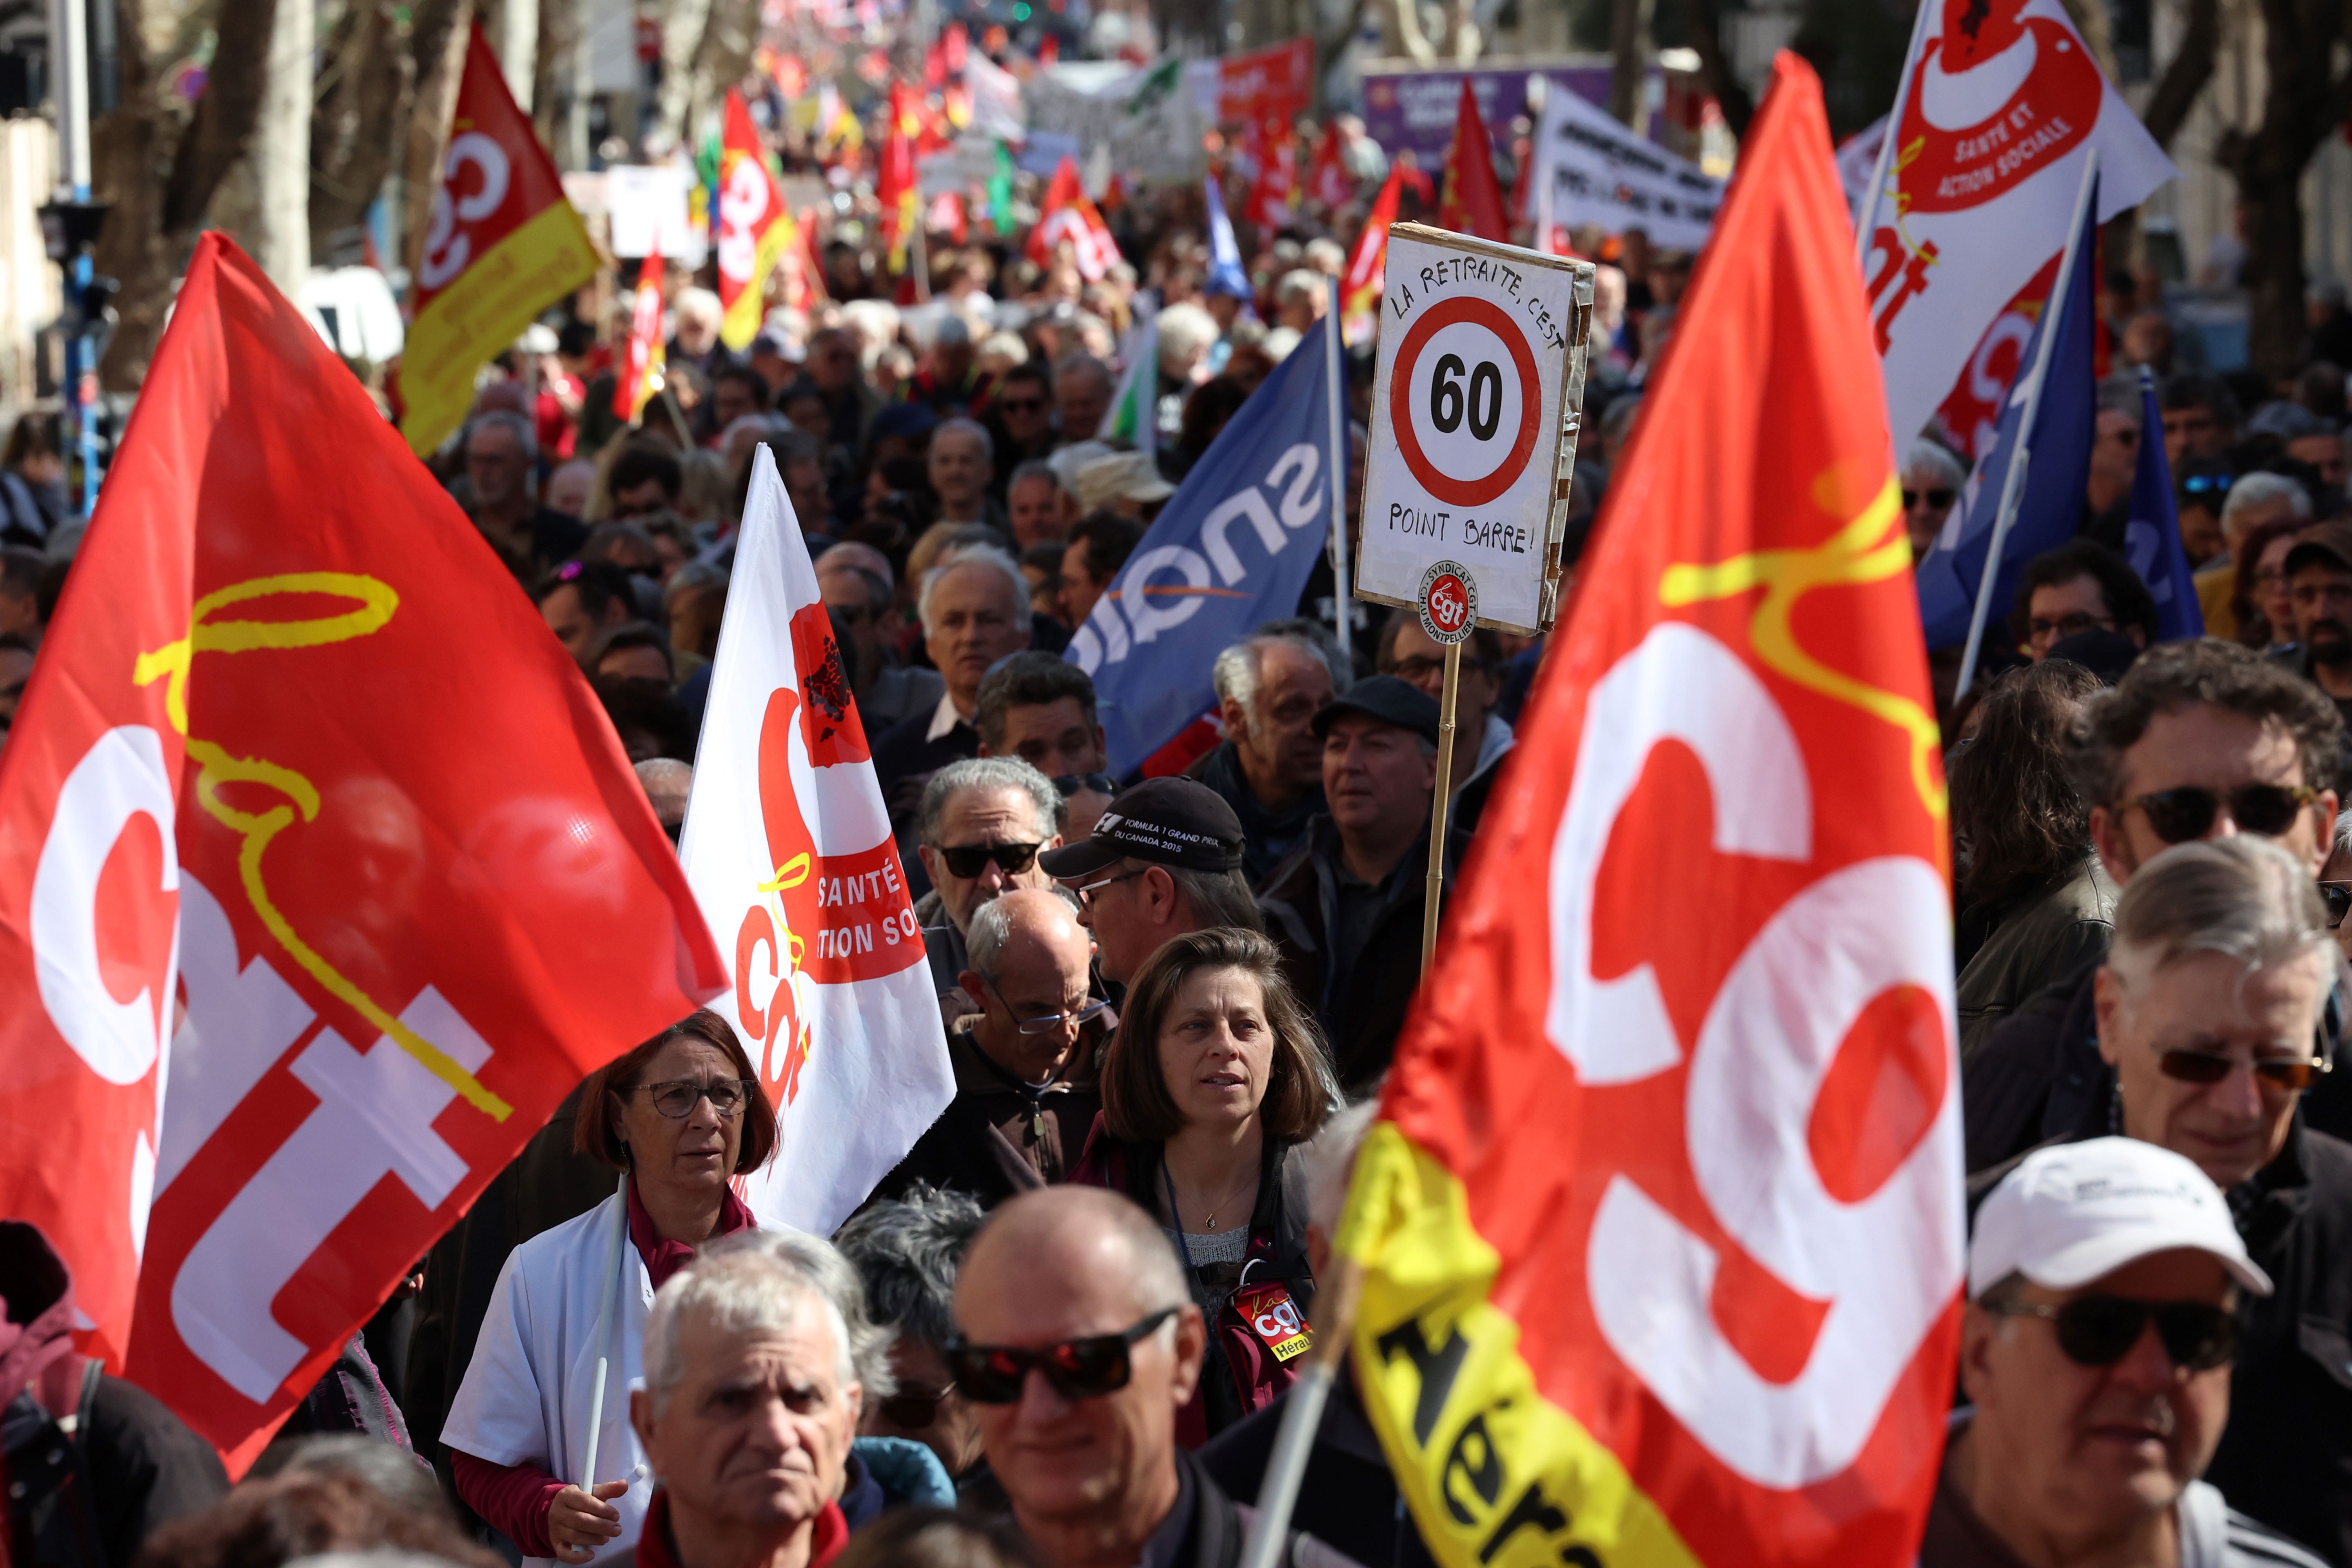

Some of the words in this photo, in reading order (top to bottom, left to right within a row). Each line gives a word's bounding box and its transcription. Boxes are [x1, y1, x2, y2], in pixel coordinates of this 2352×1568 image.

[1996, 116, 2073, 177] SOCIALE
[1390, 284, 1414, 319] LA
[1420, 256, 1522, 304] RETRAITE,
[1528, 298, 1565, 349] C'EST
[1430, 353, 1502, 441] 60
[1428, 563, 1471, 584] SYNDICAT
[1468, 586, 1476, 612] CGT
[1431, 592, 1464, 626] cgt
[1423, 617, 1473, 642] MONTPELLIER
[1114, 830, 1125, 838] DU
[1125, 833, 1159, 846] CANADA
[1161, 842, 1183, 852] 2015
[1125, 819, 1159, 833] FORMULA
[1168, 829, 1200, 842] GRAND
[1201, 836, 1218, 847] PRIX
[818, 857, 900, 908] SANTÉ
[817, 923, 873, 959] TION
[882, 905, 917, 946] SO
[1544, 622, 1965, 1490] cg
[1276, 1338, 1312, 1357] Hérau
